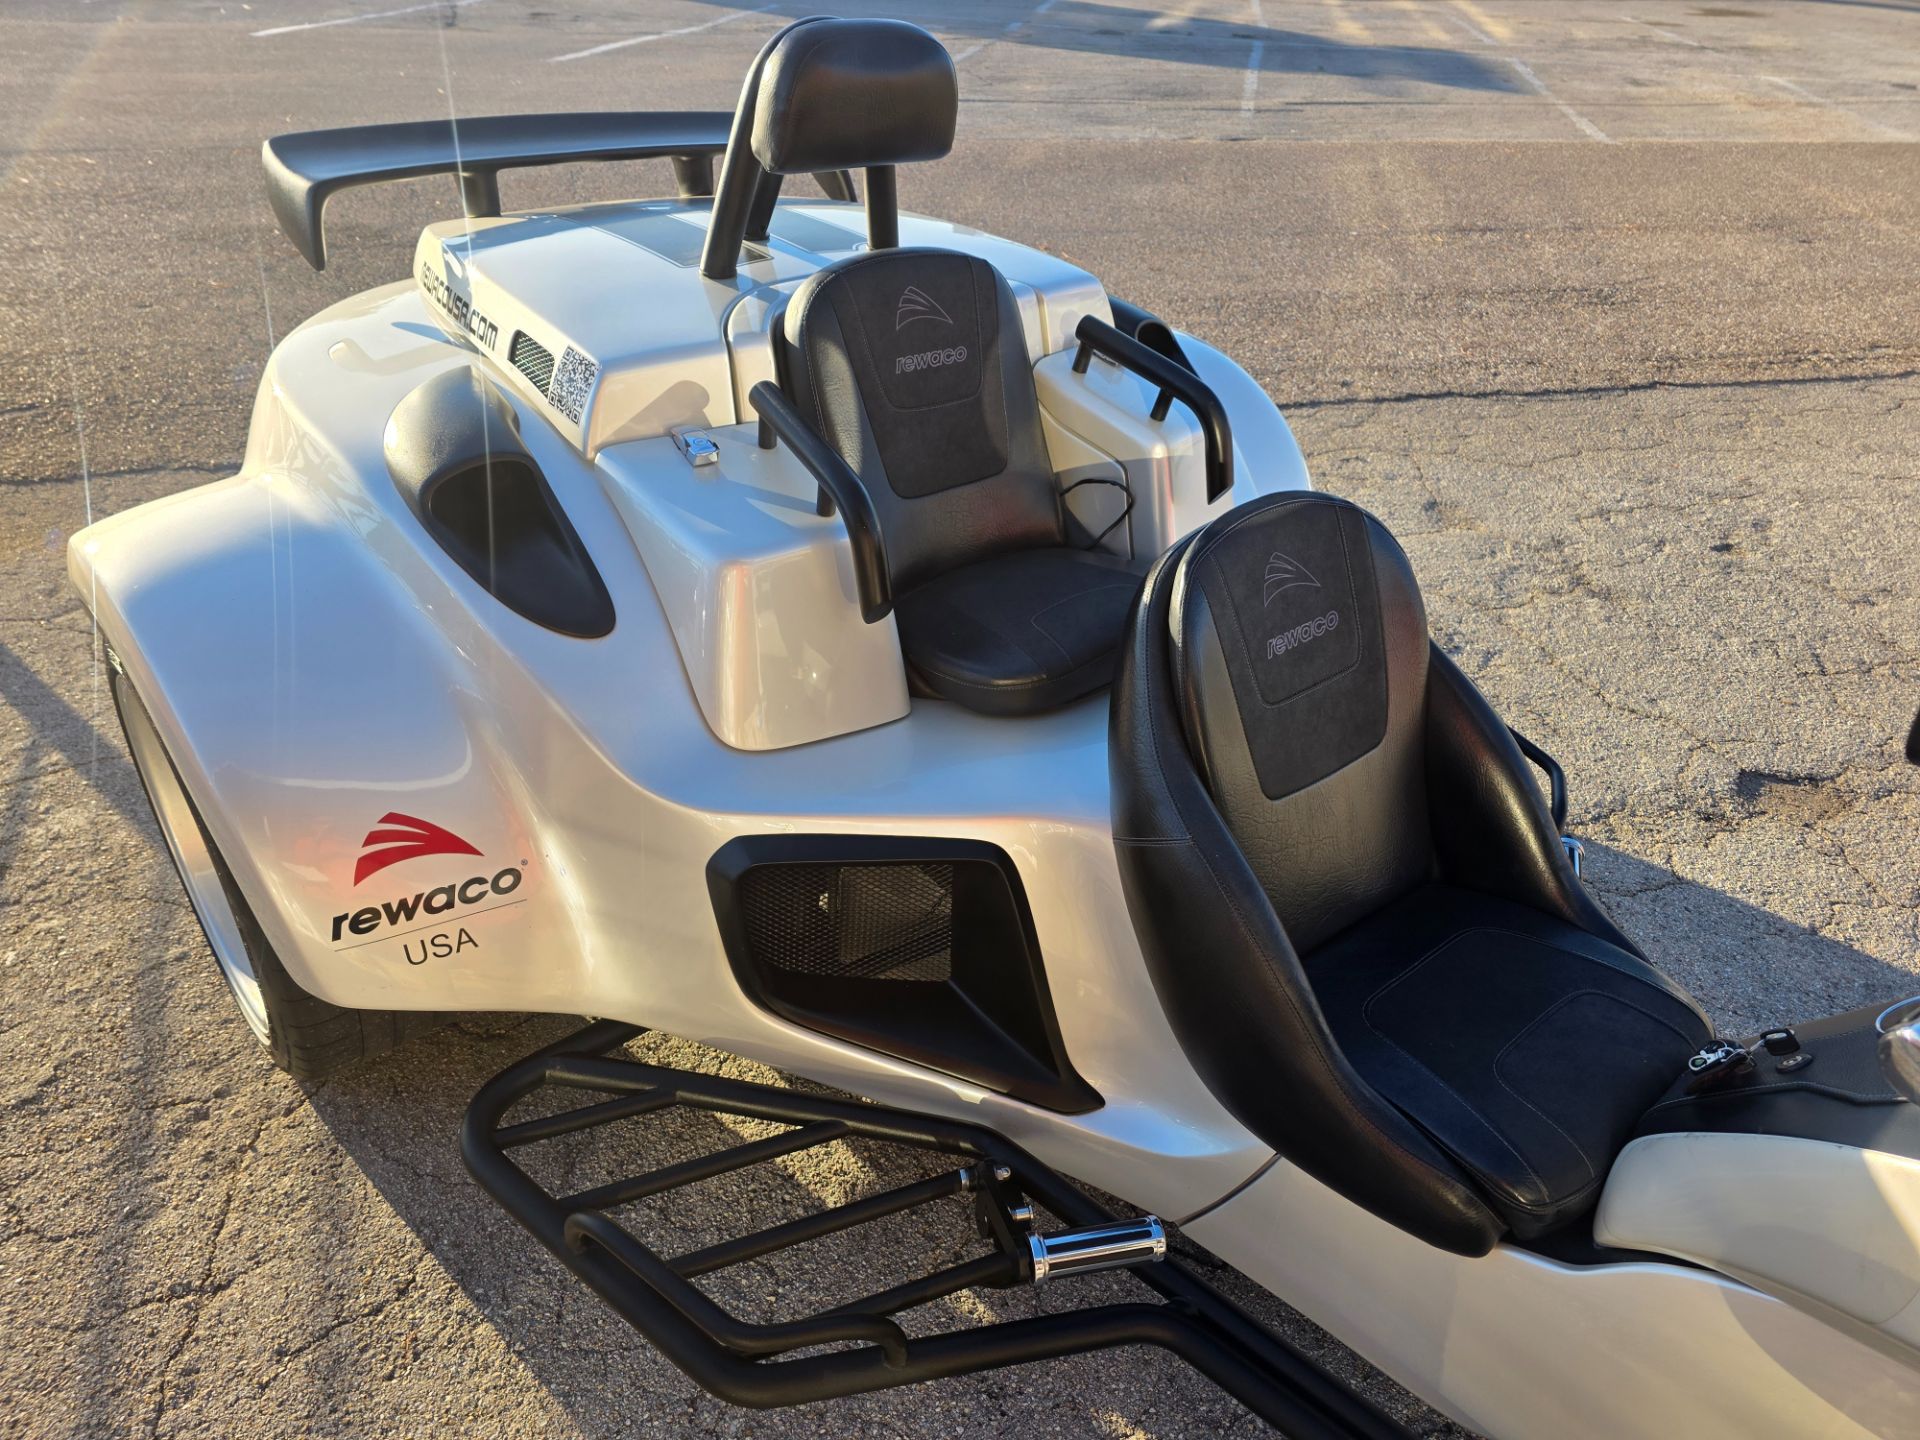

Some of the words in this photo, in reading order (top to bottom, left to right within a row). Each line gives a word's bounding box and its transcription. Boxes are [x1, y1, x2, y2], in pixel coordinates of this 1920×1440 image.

[895, 345, 967, 375] rewaco
[1266, 610, 1339, 660] rewaco
[403, 927, 479, 966] USA
